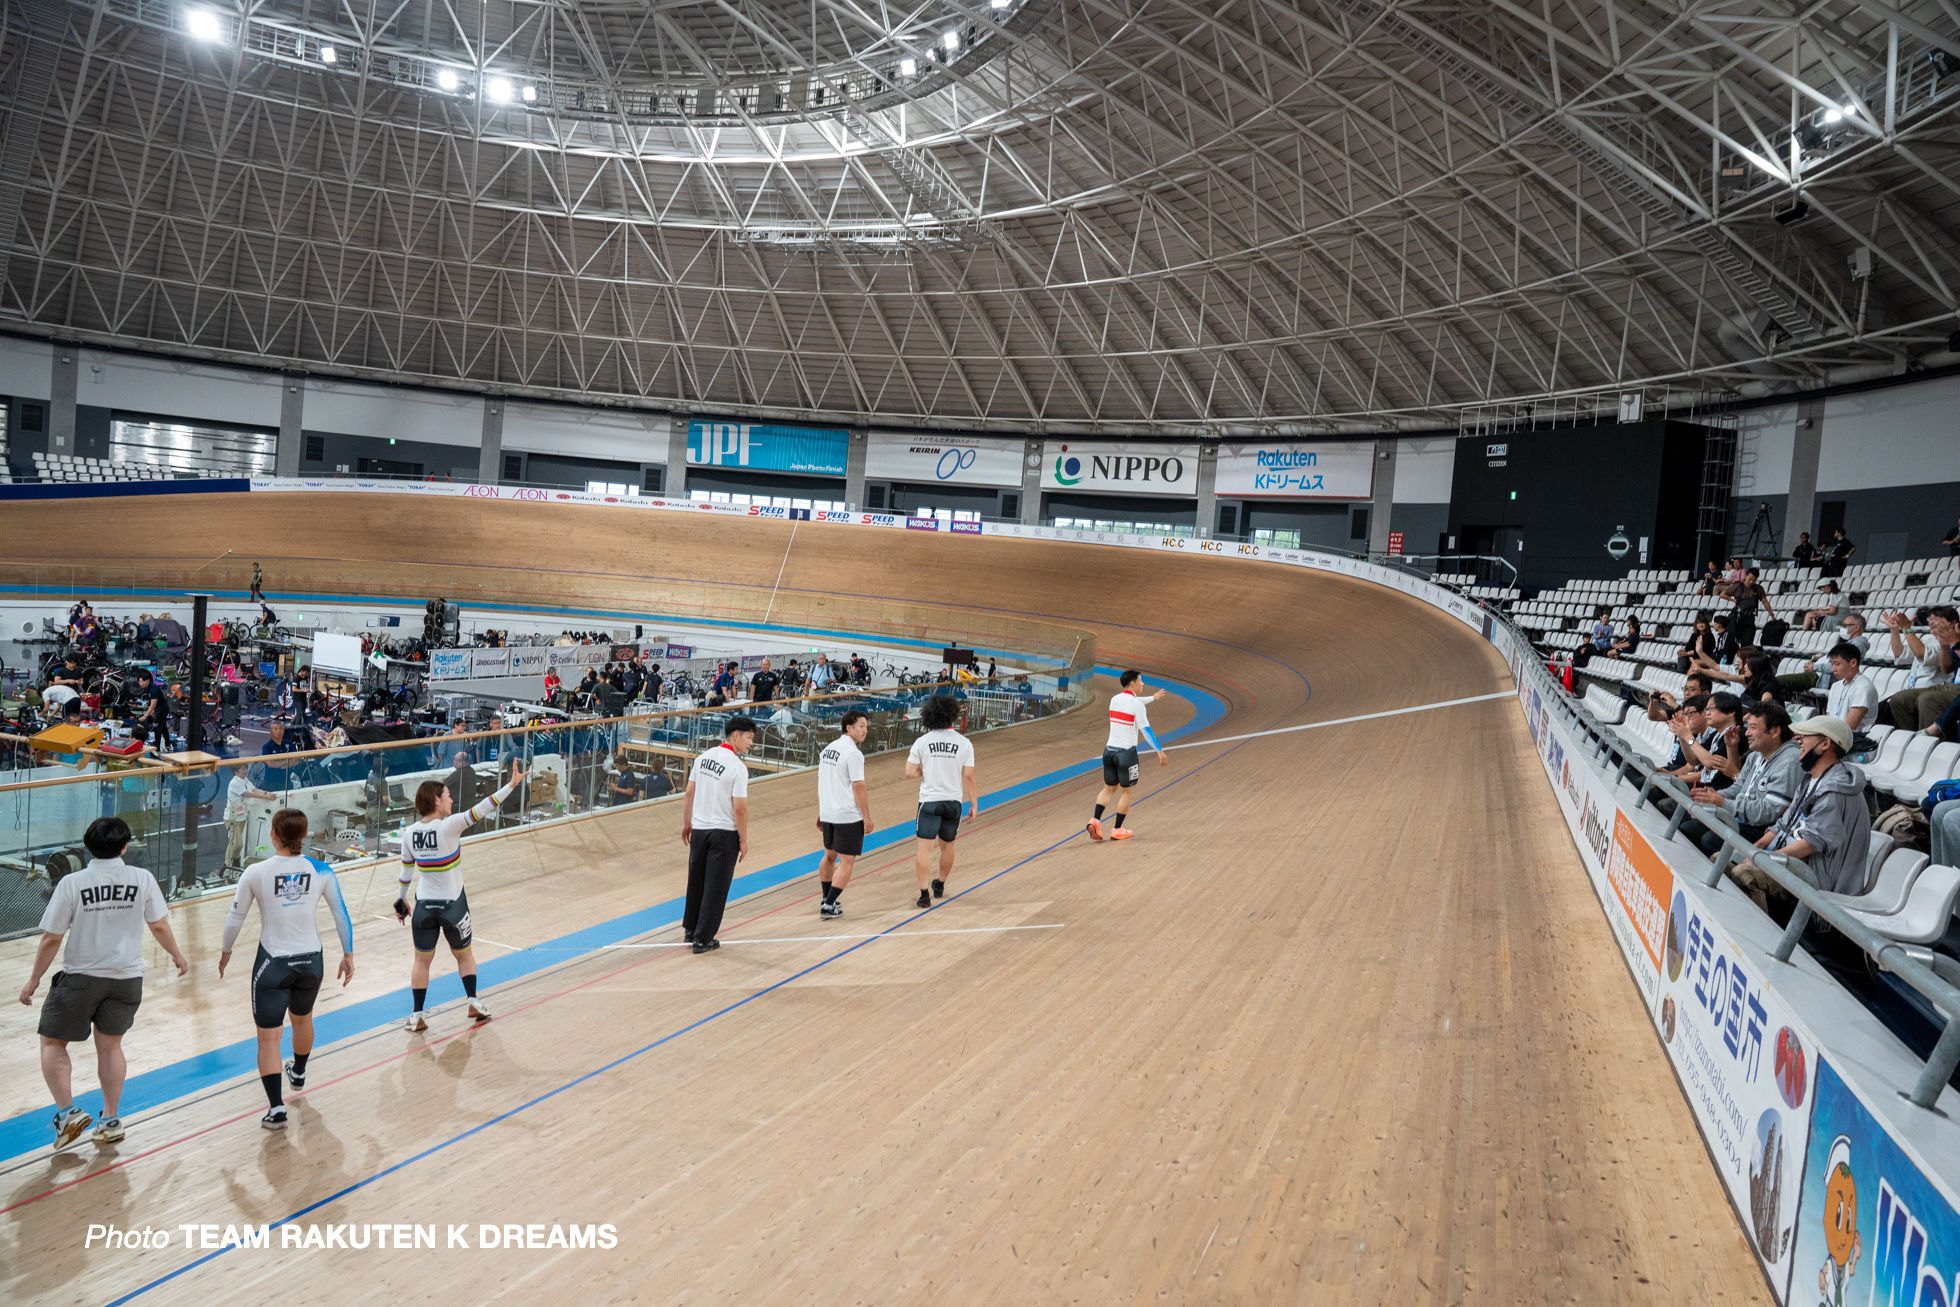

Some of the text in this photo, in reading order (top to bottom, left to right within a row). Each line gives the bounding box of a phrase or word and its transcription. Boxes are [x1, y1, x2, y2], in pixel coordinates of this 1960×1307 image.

[686, 423, 764, 466] JPF
[909, 446, 941, 455] KEIRIN
[1257, 450, 1317, 468] Rakuten
[1488, 460, 1507, 468] CITIZEN
[789, 462, 843, 473] Japan Photo Finish
[1090, 455, 1184, 483] NIPPO
[1255, 473, 1324, 490] Kドリームス
[748, 505, 784, 516] SPEED
[816, 510, 850, 521] SPEED
[861, 514, 895, 524] SPEED
[434, 653, 463, 663] Rakuten
[521, 655, 543, 665] NIPPO
[557, 656, 576, 664] Cyclers
[642, 648, 664, 660] SPEED
[434, 665, 467, 675] Kドリームス
[928, 742, 959, 755] RIDER
[700, 759, 726, 777] RIDER
[412, 830, 438, 849] RKD
[80, 884, 139, 906] RIDER
[1684, 910, 1768, 1084] 伊豆の国市
[1679, 1000, 1749, 1142] http://izunotabi.com/
[1675, 1031, 1742, 1177] TEL 055-948-0304
